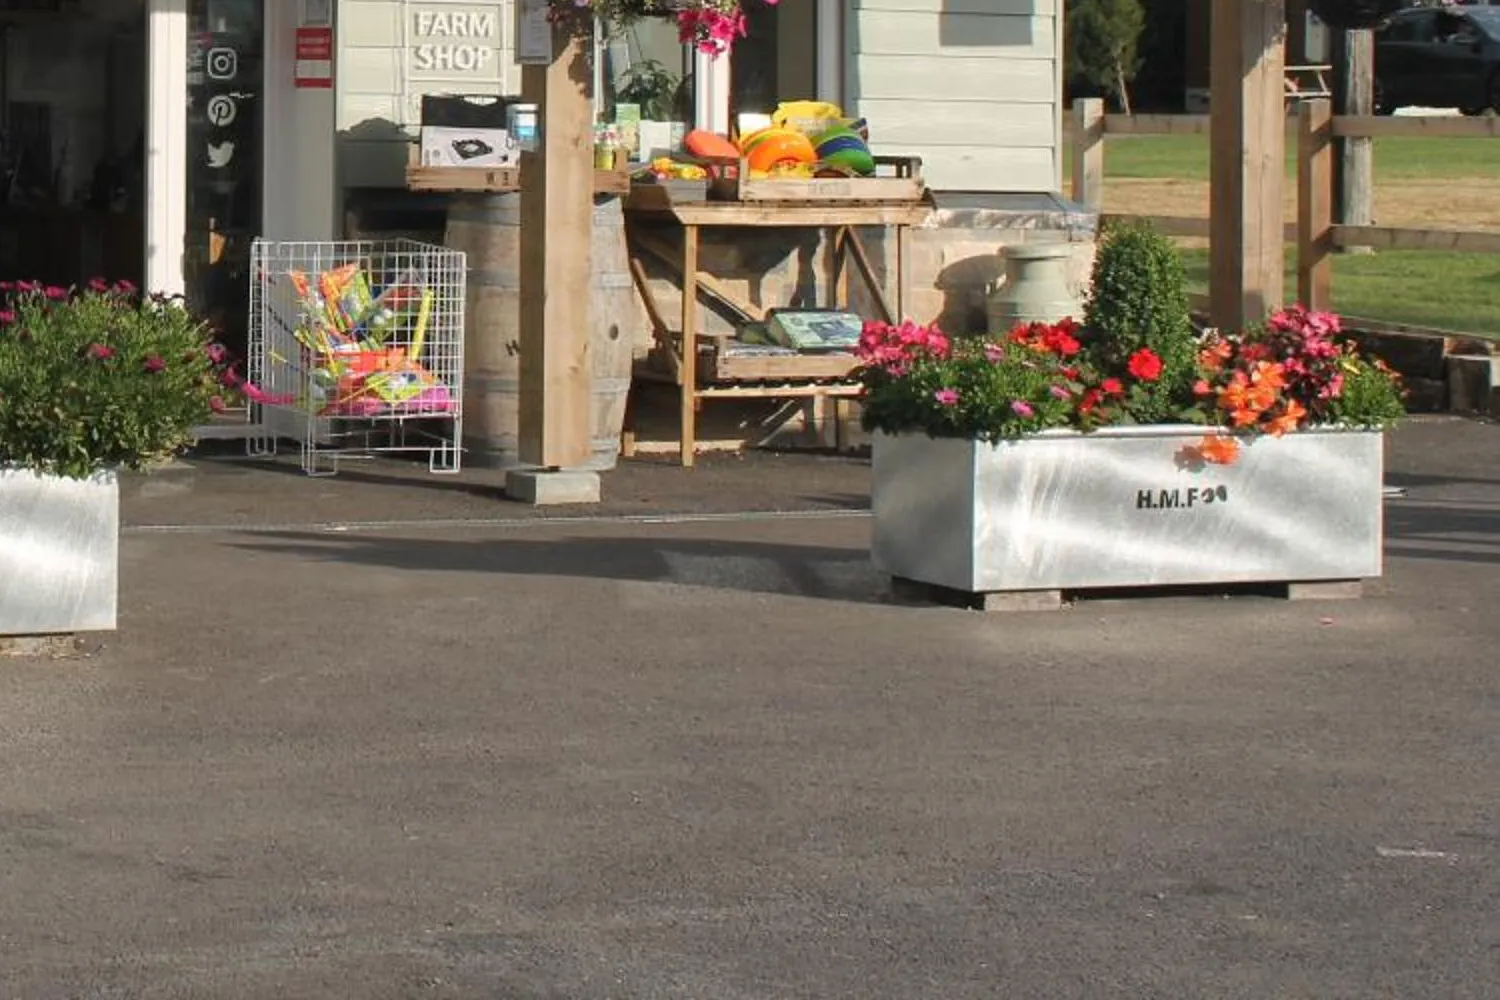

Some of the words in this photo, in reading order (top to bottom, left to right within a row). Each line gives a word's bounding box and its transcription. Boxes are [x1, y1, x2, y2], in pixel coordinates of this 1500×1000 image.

[417, 10, 495, 37] FARM
[416, 43, 493, 70] SHOP
[1136, 487, 1199, 509] H.M.F
